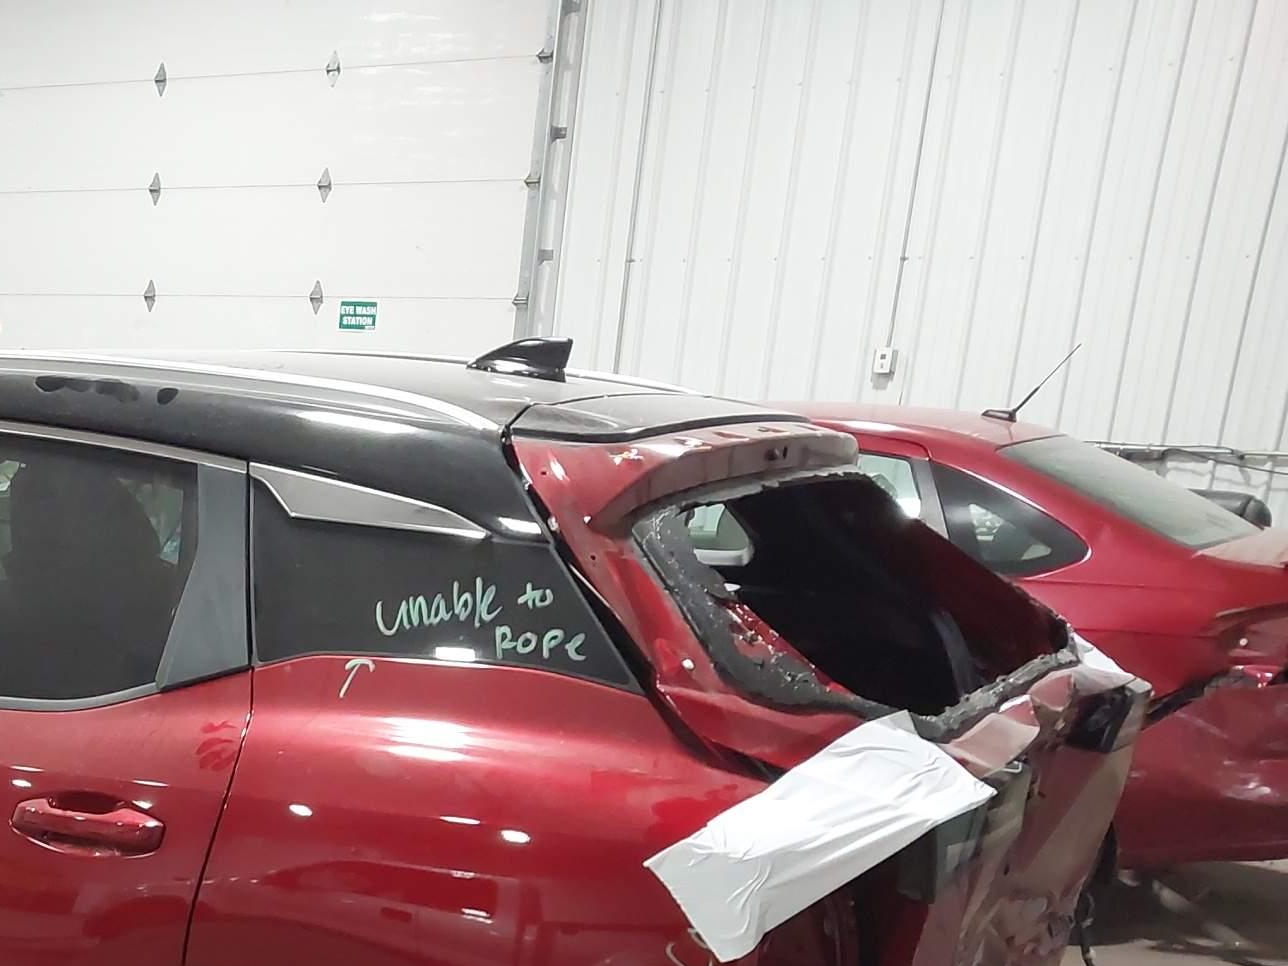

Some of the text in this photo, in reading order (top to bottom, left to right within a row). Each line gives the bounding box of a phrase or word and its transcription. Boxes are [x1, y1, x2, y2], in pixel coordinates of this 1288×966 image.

[341, 305, 377, 316] EYE WASH
[342, 316, 373, 326] STATION
[517, 581, 554, 610] to
